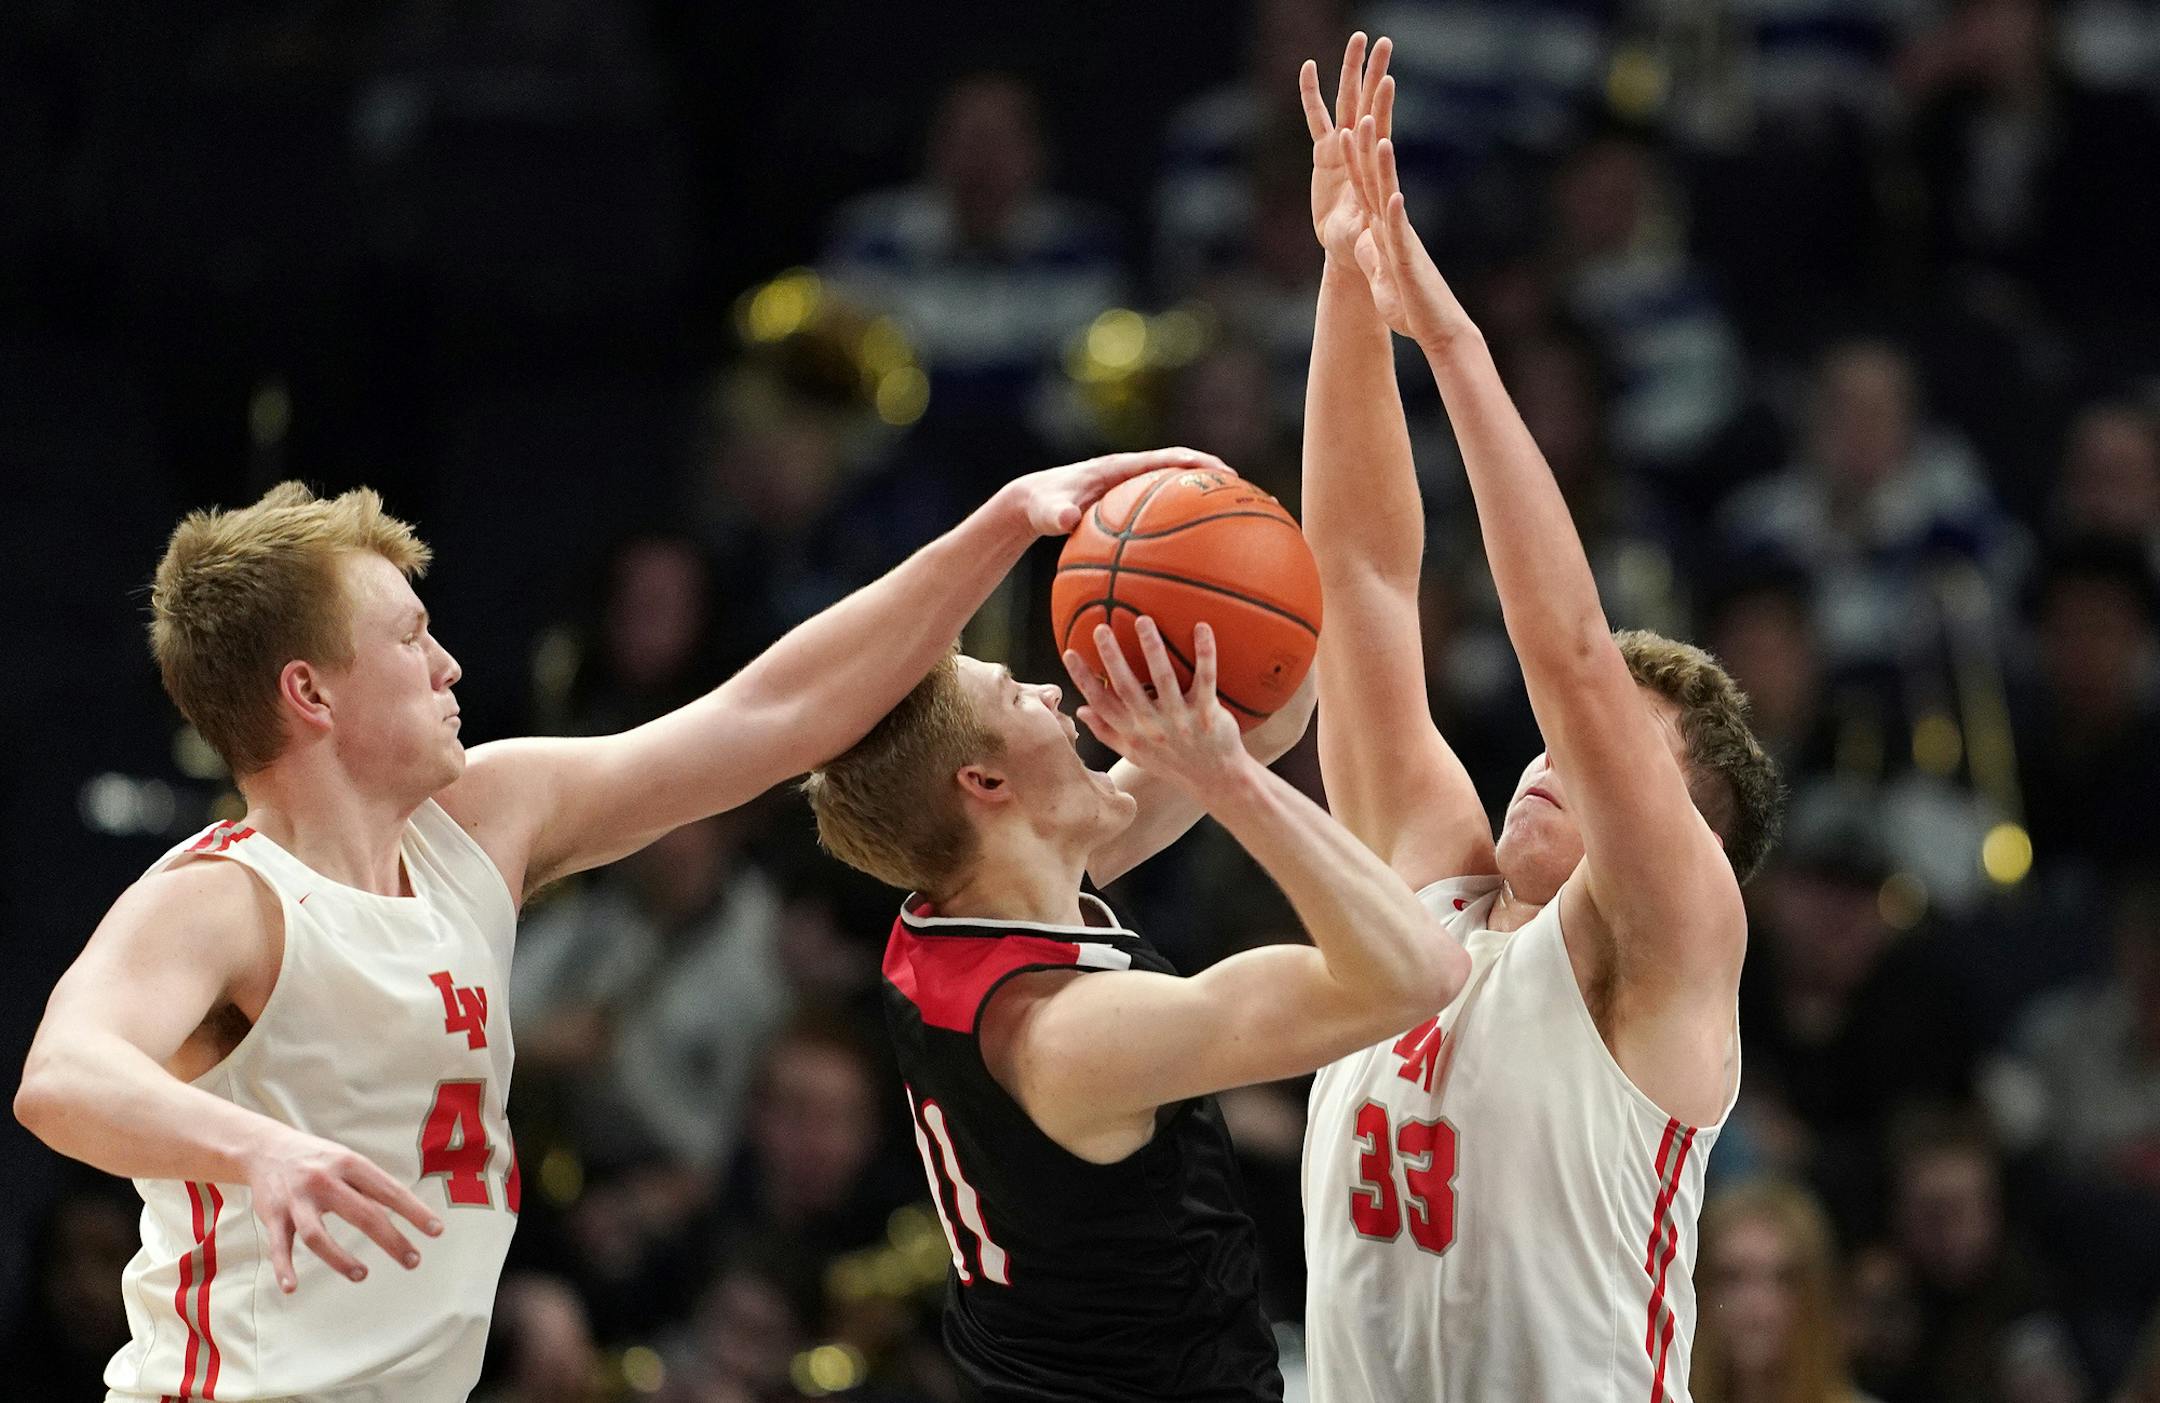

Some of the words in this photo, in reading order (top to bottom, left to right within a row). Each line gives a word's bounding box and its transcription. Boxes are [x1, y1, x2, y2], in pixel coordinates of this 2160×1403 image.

[428, 970, 488, 1050] LN
[416, 1077, 521, 1214] 4
[903, 1081, 1011, 1286] 11
[1349, 1097, 1460, 1256] 33
